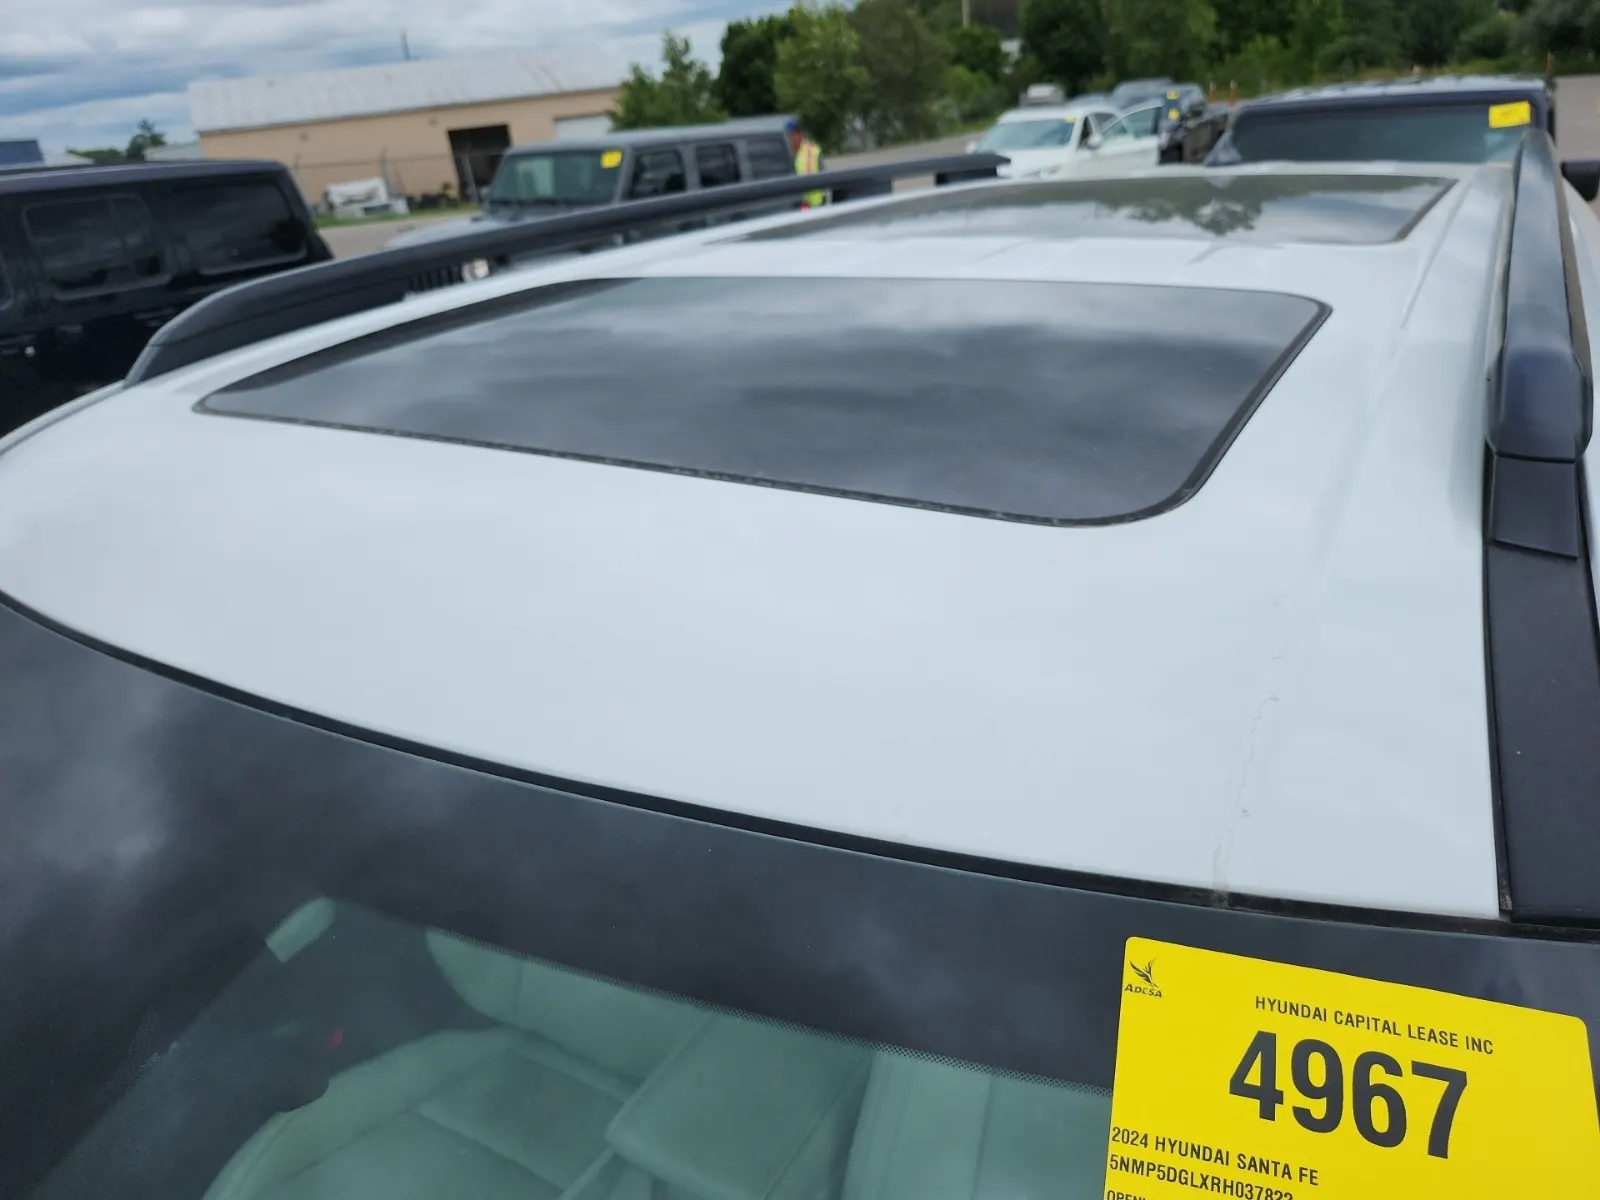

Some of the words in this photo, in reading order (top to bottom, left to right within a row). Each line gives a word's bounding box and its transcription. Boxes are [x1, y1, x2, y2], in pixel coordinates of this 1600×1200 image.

[1124, 983, 1162, 998] ADESA
[1255, 995, 1327, 1022] HYUNDAI
[1334, 1010, 1401, 1036] CAPITAL
[1407, 1024, 1458, 1048] LEASE
[1465, 1036, 1494, 1055] INC
[1229, 1030, 1468, 1160] 4967
[1111, 1126, 1149, 1149] 2024
[1155, 1135, 1230, 1167] HYUNDAI
[1237, 1153, 1293, 1181] SANTA
[1298, 1166, 1319, 1186] FE
